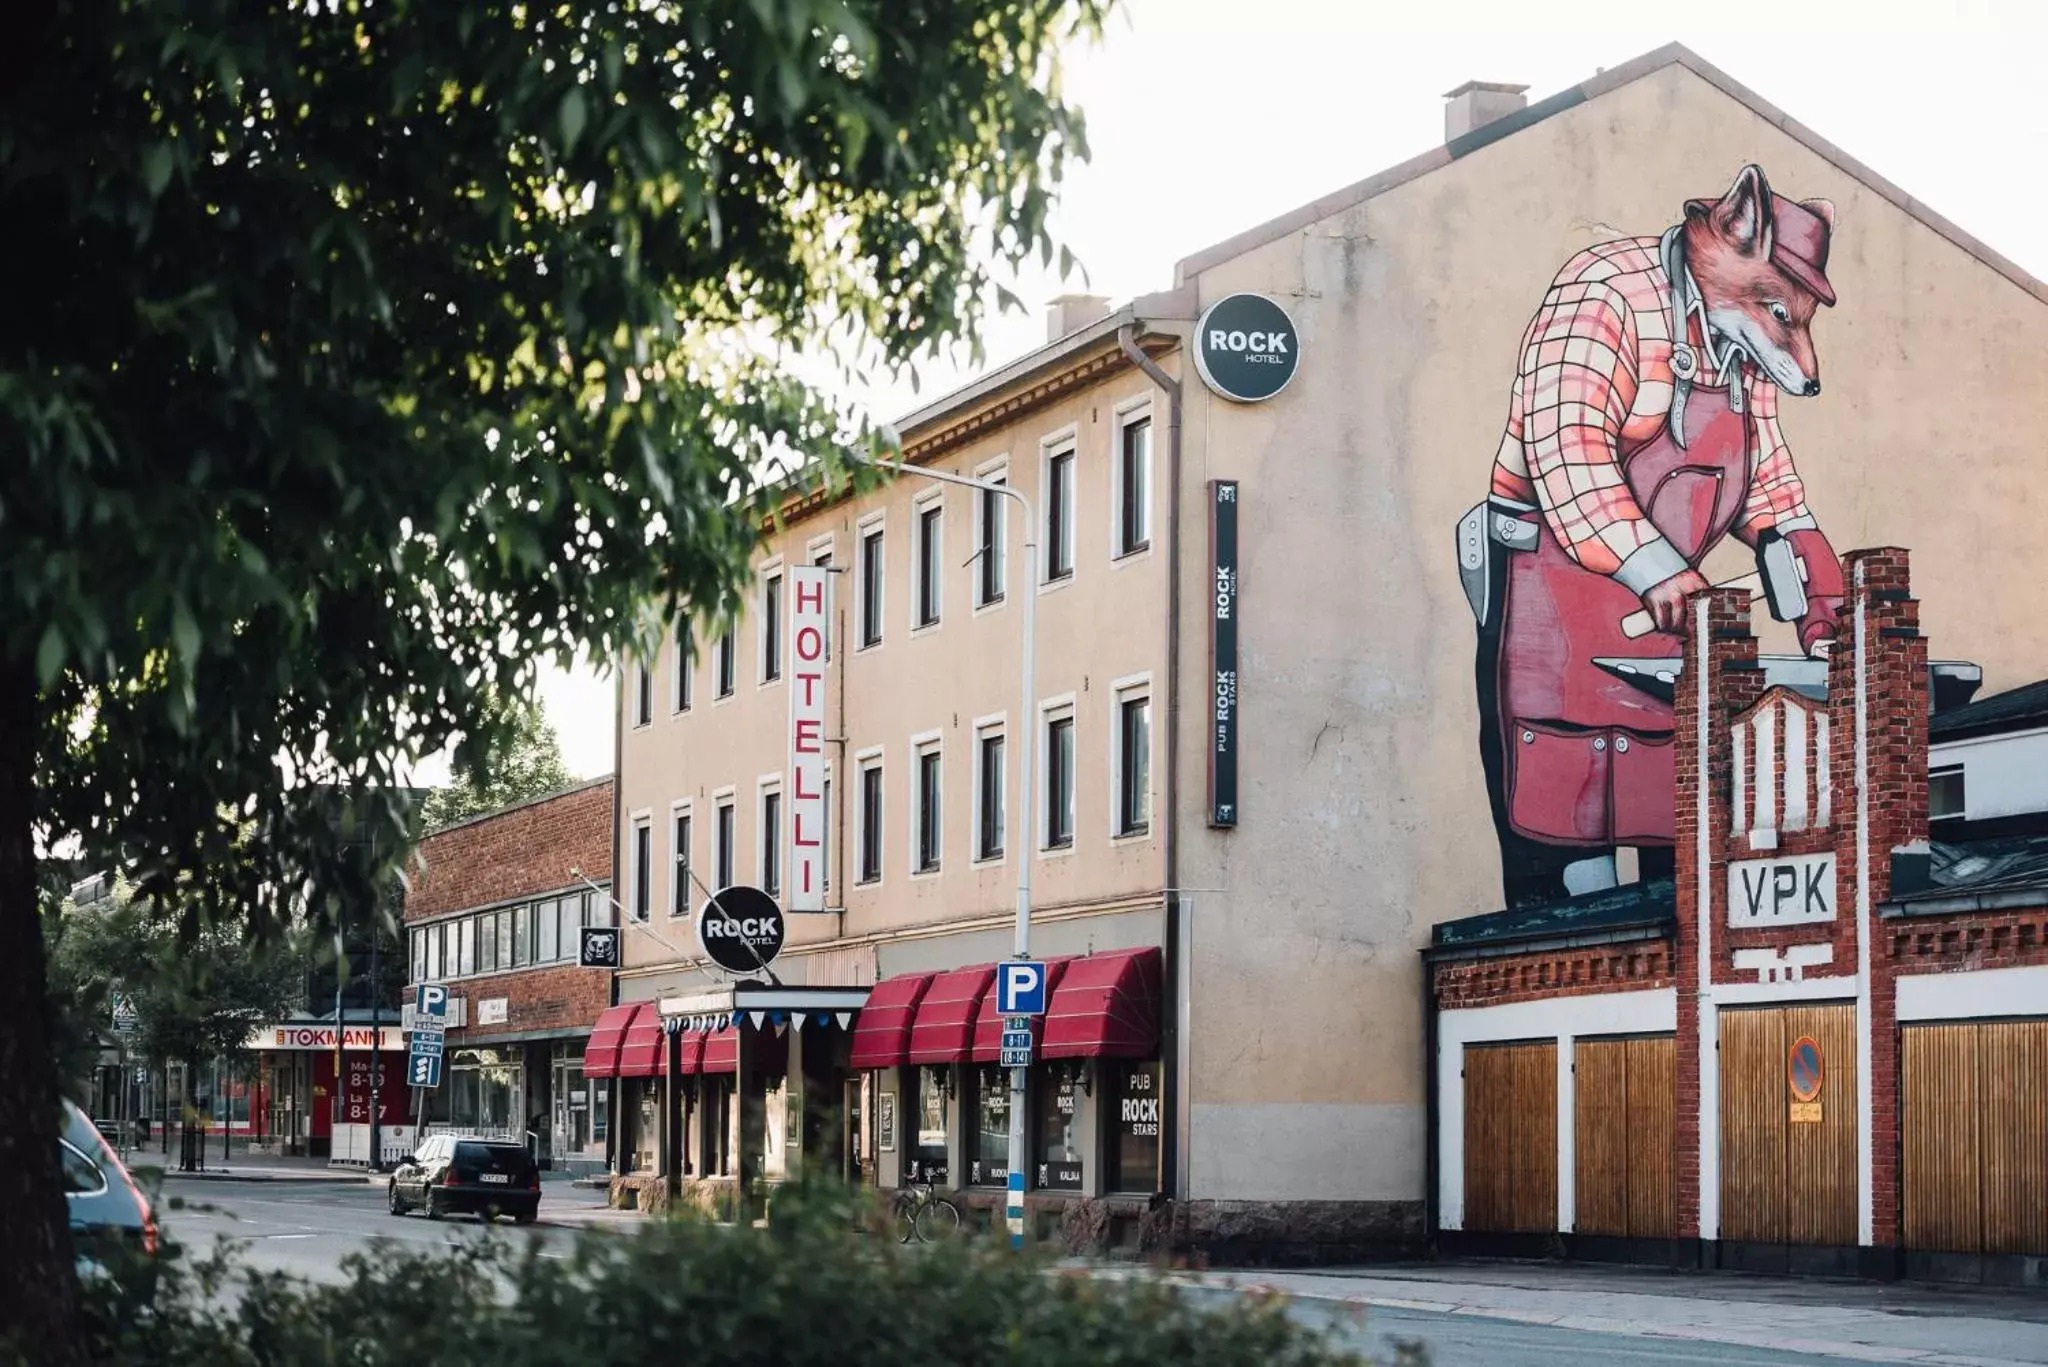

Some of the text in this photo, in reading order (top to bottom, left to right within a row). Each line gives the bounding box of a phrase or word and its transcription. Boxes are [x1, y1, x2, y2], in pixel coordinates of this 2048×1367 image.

[1209, 330, 1288, 353] ROCK
[1245, 354, 1284, 364] HOTEL
[1217, 566, 1230, 620] ROCK
[1229, 671, 1237, 706] STARS
[1217, 671, 1229, 752] PUB ROCK
[795, 580, 822, 893] HOTELLI
[1742, 862, 1828, 917] VPK
[706, 916, 778, 938] ROCK
[739, 936, 776, 946] HOTEL
[422, 986, 444, 1013] P
[1007, 966, 1038, 1010] P
[287, 1029, 386, 1046] TOKMANNI
[350, 1062, 386, 1071] Ma-e
[1130, 1074, 1151, 1090] PUB
[1122, 1098, 1158, 1122] ROCK
[1133, 1124, 1158, 1136] STARS
